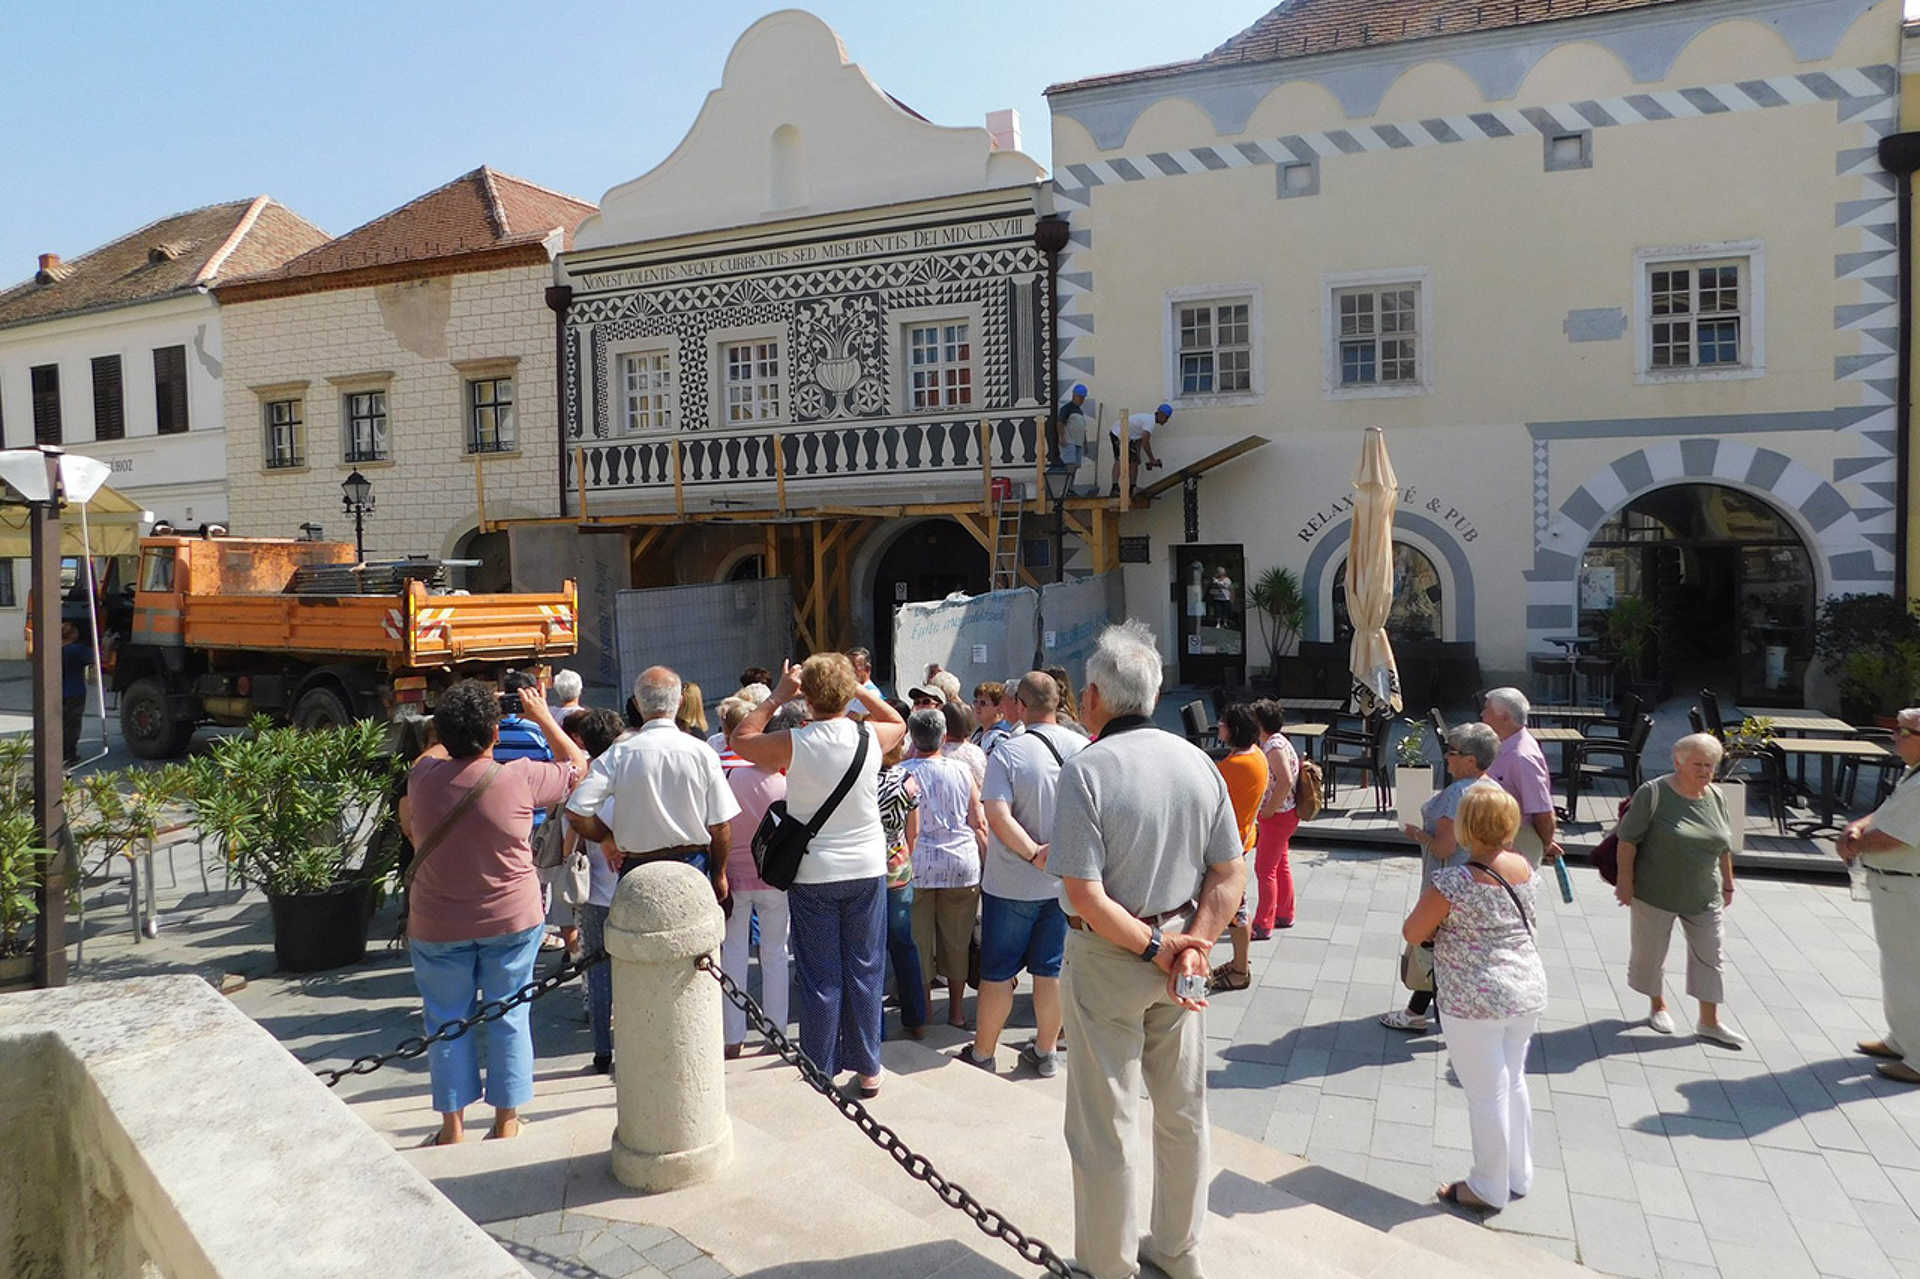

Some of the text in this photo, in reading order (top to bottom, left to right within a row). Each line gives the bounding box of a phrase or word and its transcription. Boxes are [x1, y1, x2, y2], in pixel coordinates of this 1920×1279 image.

[720, 249, 789, 272] CURRENTIS
[793, 247, 817, 263] SED
[822, 235, 908, 258] MISERENTIS
[914, 230, 937, 248] DEI
[943, 218, 1023, 244] MDCLXVIII
[1297, 493, 1479, 543] RELAX & PUB
